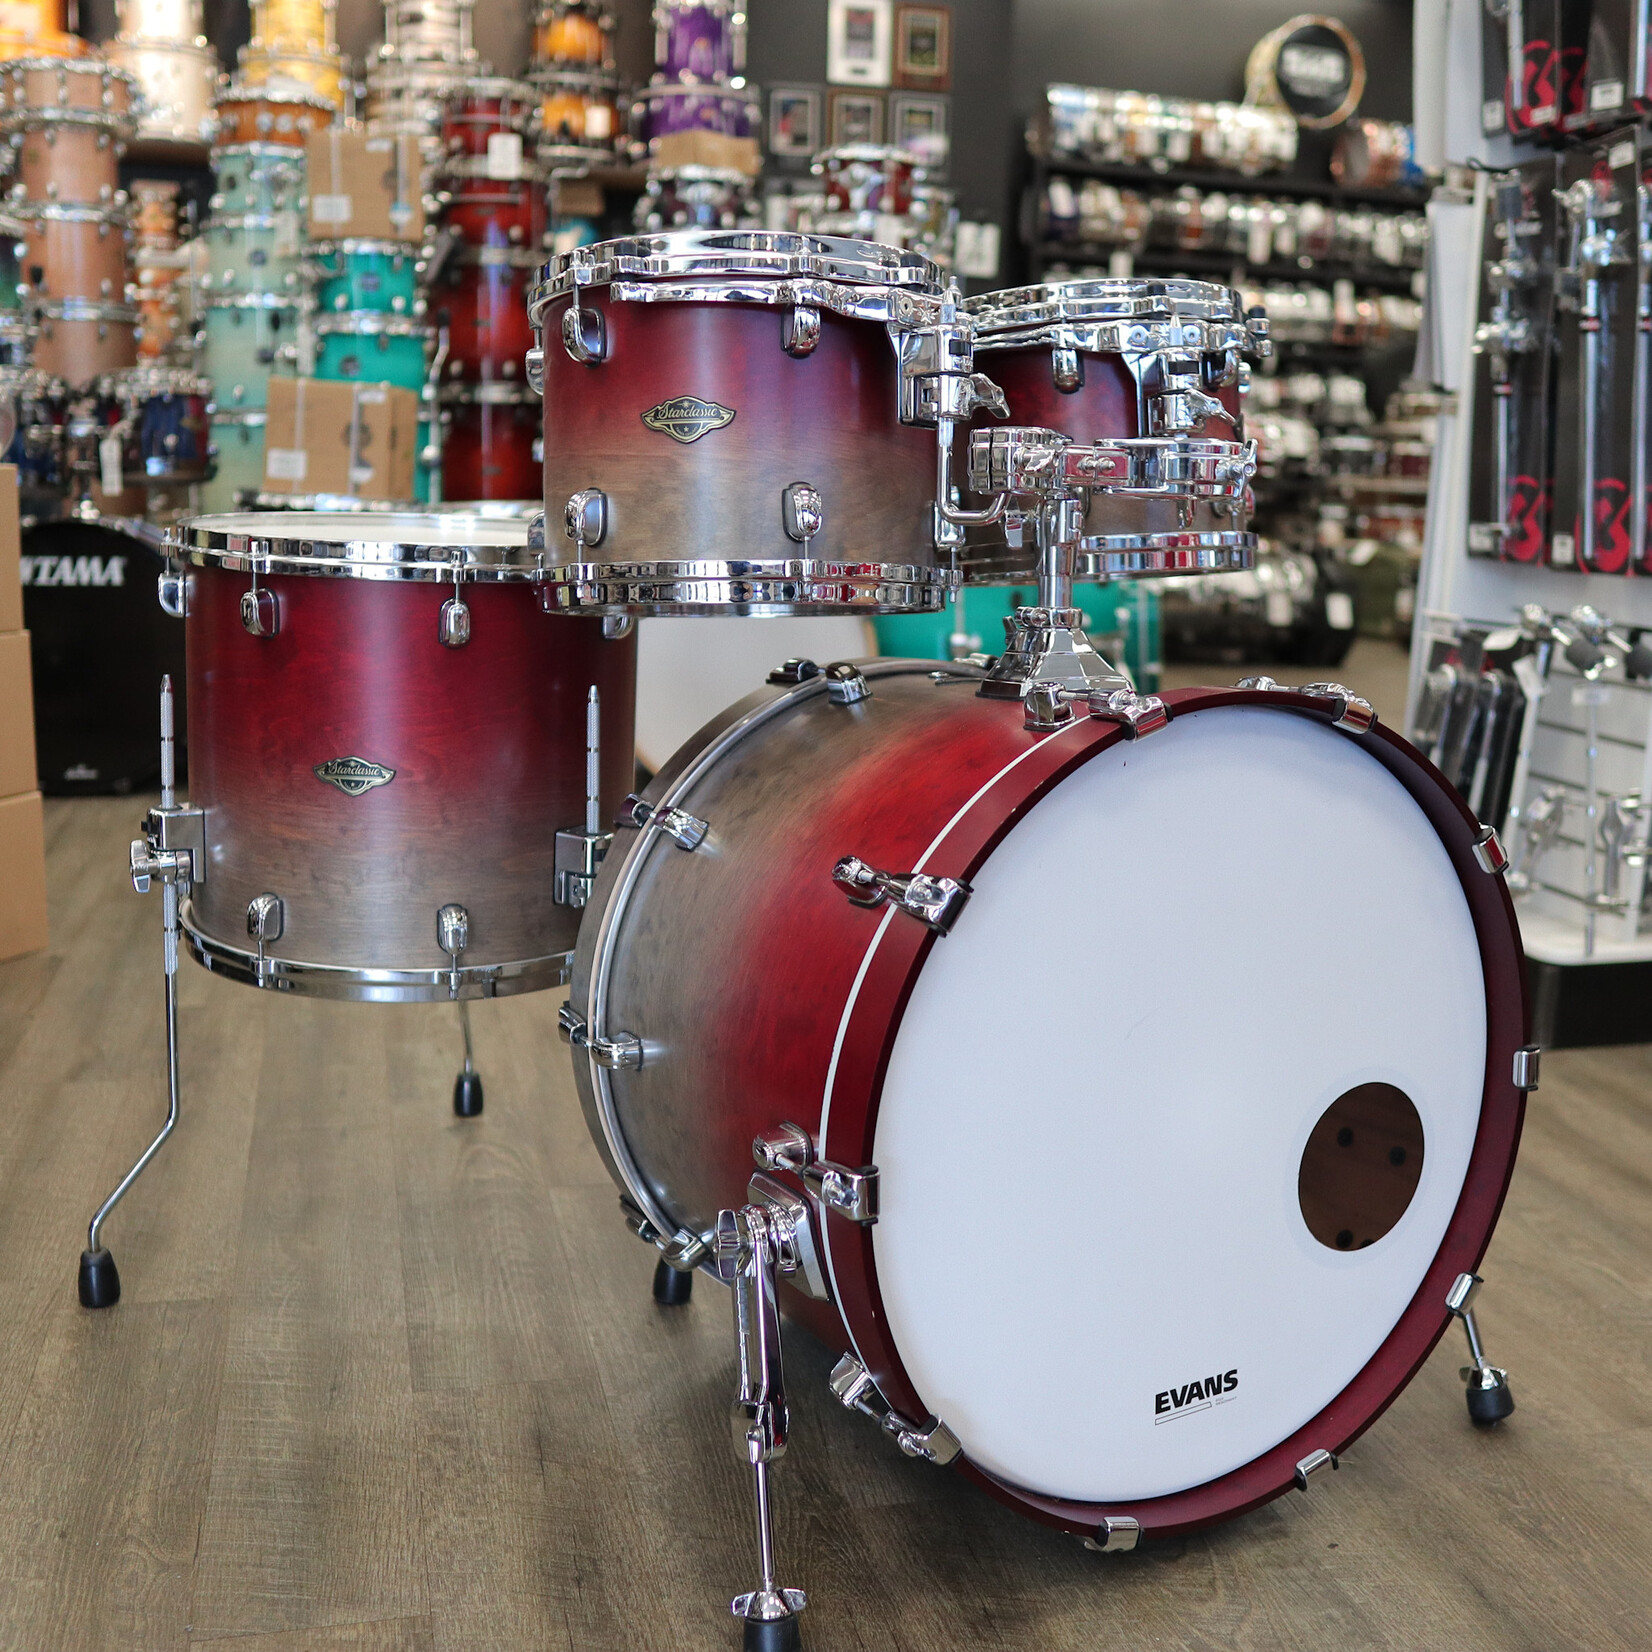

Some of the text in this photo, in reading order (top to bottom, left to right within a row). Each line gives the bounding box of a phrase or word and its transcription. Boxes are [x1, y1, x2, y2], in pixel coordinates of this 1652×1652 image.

[656, 403, 718, 419] Starclassic
[34, 555, 126, 586] TAMA
[328, 762, 380, 776] Starclassic
[1155, 1369, 1239, 1415] EVANS
